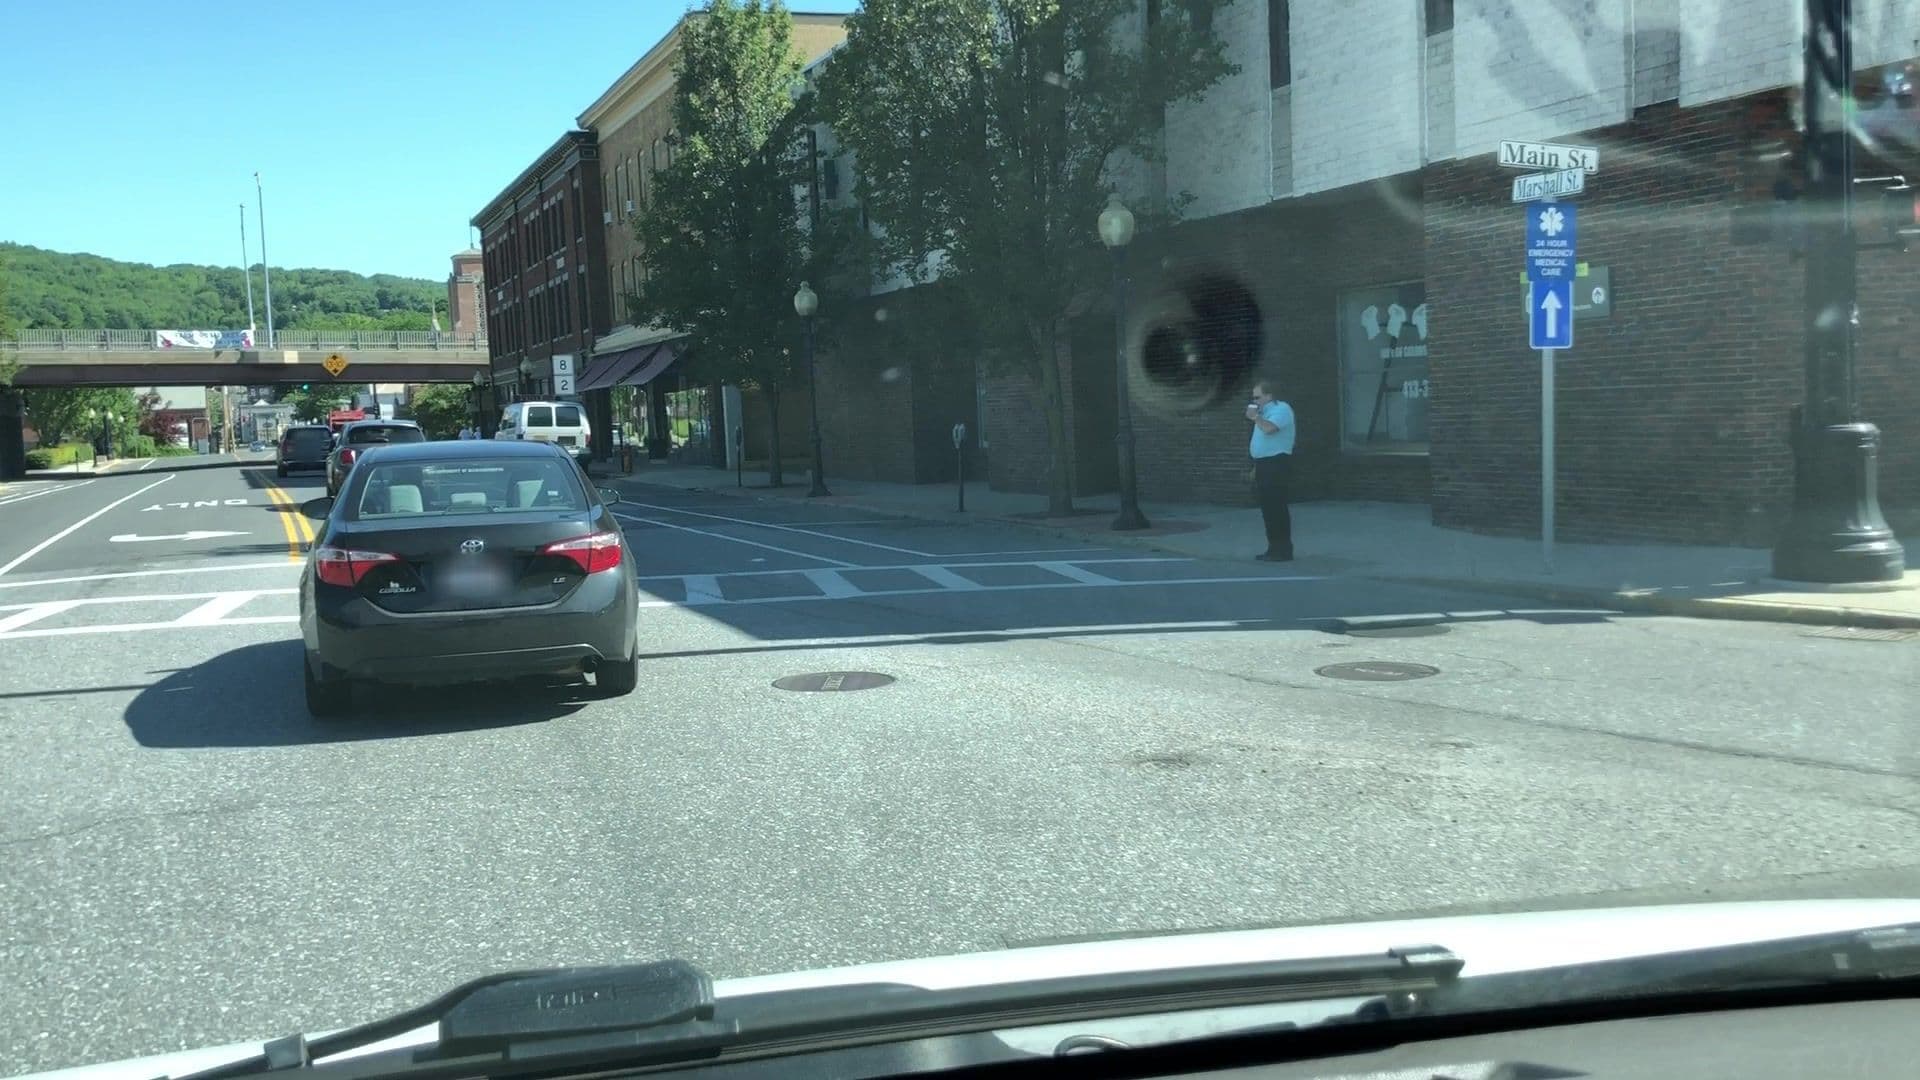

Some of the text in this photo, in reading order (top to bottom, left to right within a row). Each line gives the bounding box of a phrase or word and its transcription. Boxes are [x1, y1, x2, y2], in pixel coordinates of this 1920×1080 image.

[1504, 144, 1593, 170] Main St.
[1517, 171, 1579, 198] Marshall St.
[1528, 249, 1574, 257] EMERGENCY
[1541, 268, 1561, 276] CARE
[559, 360, 567, 370] 8
[561, 380, 568, 391] 2
[140, 499, 248, 511] ONLY
